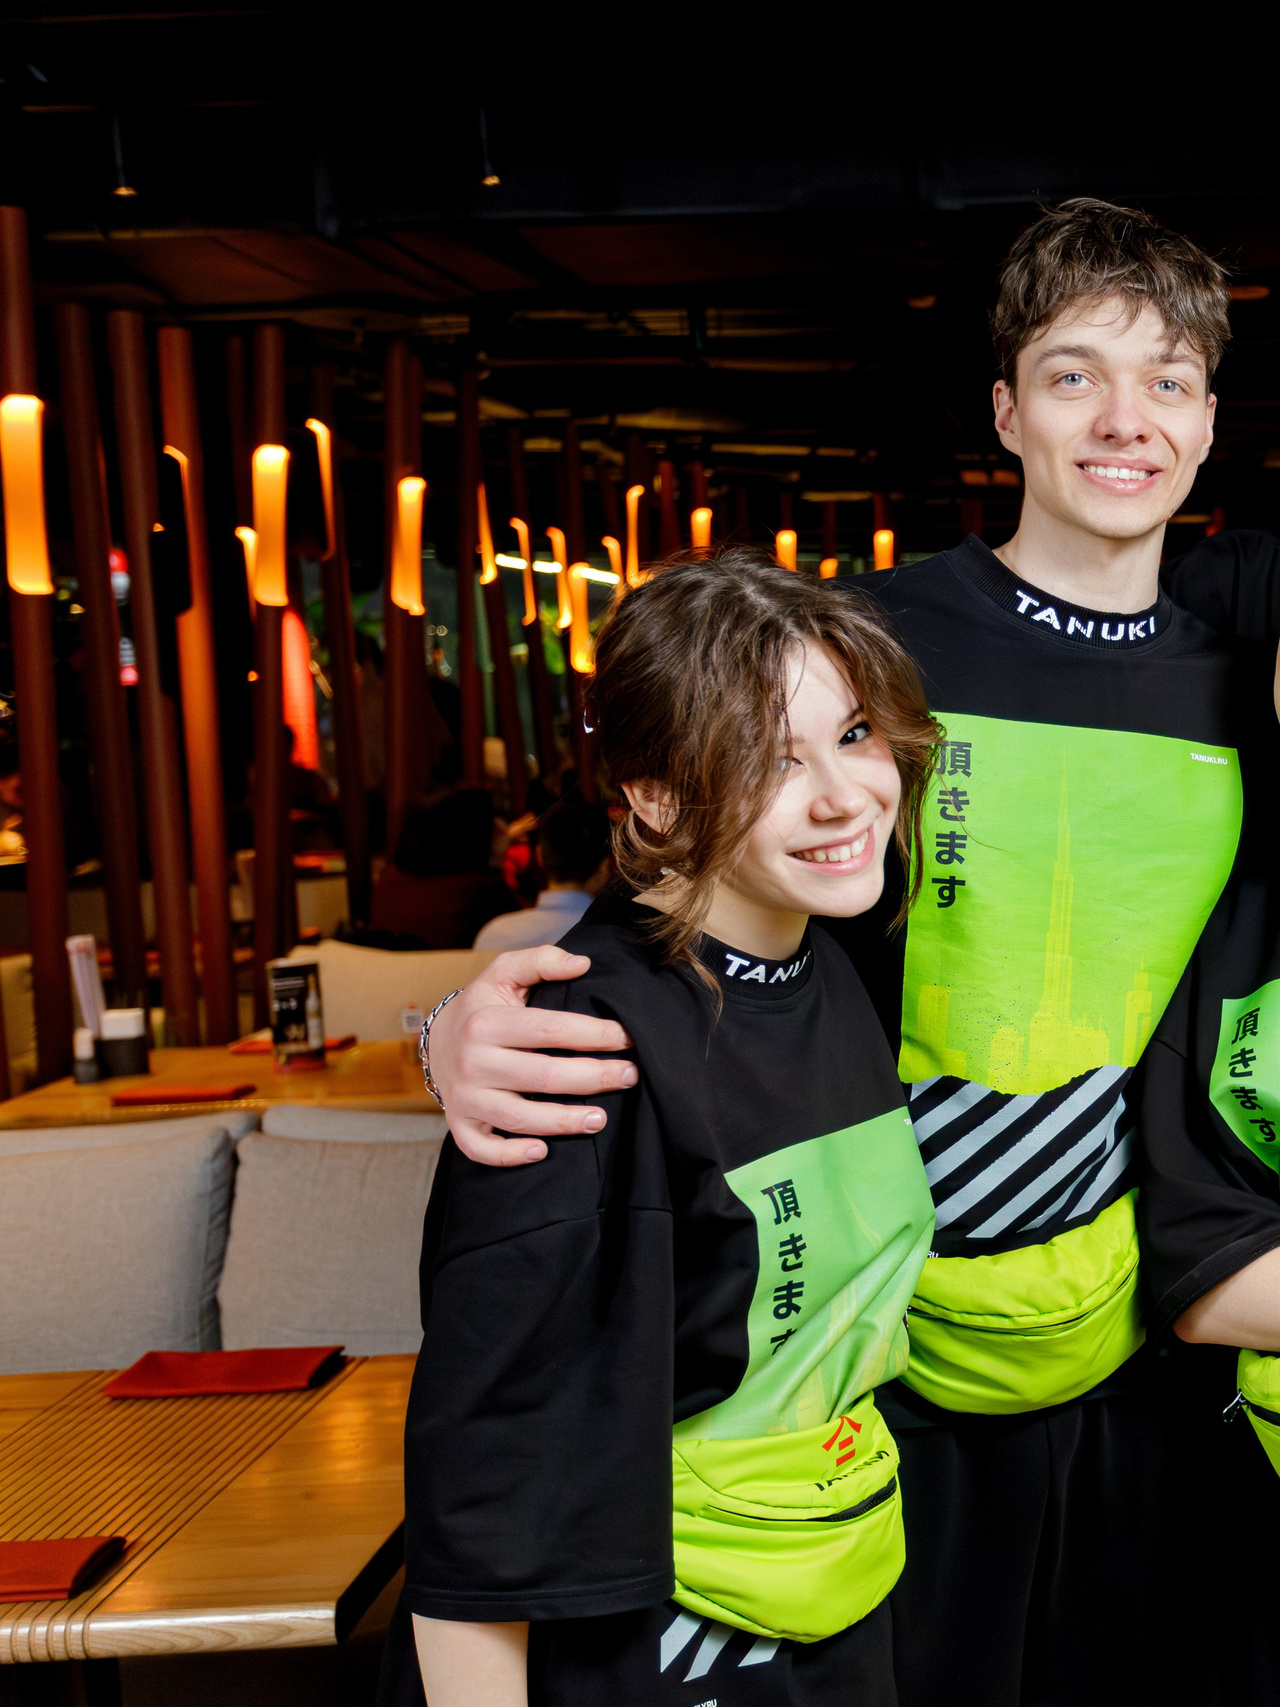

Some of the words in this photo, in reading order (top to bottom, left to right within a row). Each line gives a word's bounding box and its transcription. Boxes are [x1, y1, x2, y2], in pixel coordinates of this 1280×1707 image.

[1016, 589, 1156, 641] TANUKI
[1190, 752, 1228, 765] TANUKI.RU
[931, 740, 973, 909] 頂きます
[1228, 1007, 1277, 1142] 頂きます
